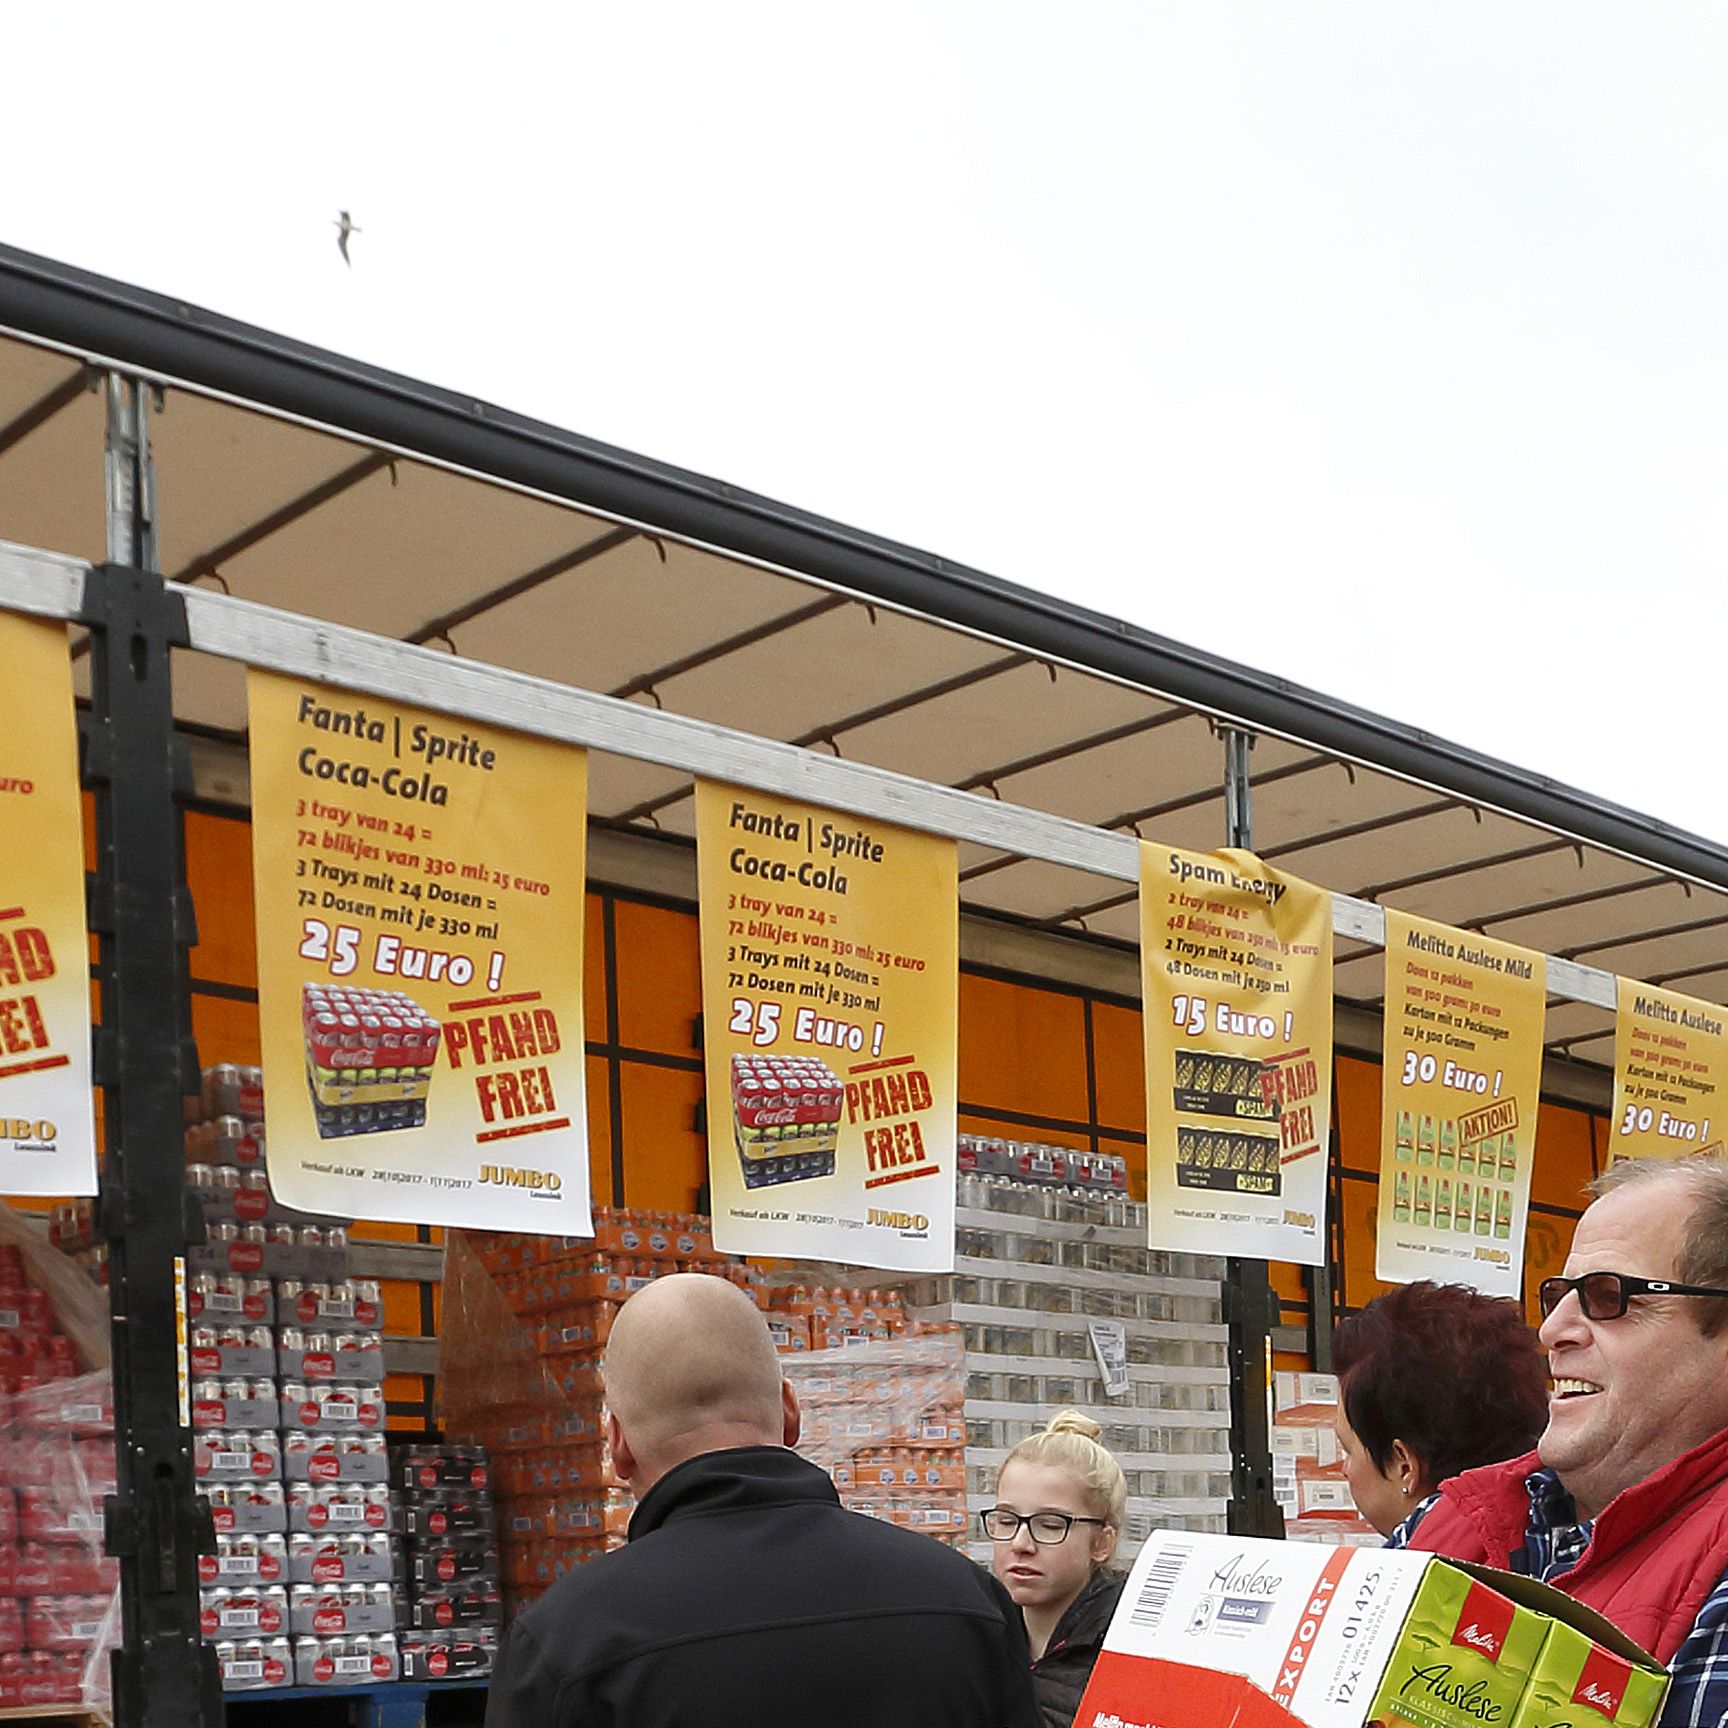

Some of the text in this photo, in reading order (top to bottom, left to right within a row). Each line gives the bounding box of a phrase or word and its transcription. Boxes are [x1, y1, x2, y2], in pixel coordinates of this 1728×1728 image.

[299, 694, 496, 770] Fanta Sprite
[299, 747, 448, 807] Coca-Cola
[312, 800, 415, 841] tray van 24
[730, 803, 884, 863] Fanta Sprite
[297, 830, 317, 848] 72
[322, 832, 380, 861] blikjes
[386, 851, 419, 868] van
[424, 858, 455, 876] 330
[493, 871, 509, 889] 25
[514, 877, 550, 897] euro
[312, 860, 481, 909] Trays mit 24 Dosen
[730, 848, 848, 894] Coca-Cola
[1169, 854, 1225, 885] Spam
[298, 889, 498, 940] 72 Dosen mit je 330 ml
[740, 894, 804, 919] tray van
[300, 919, 474, 986] 25 Euro
[740, 946, 869, 984] Trays mit Dosen
[748, 921, 925, 972] blikjes euro
[1407, 930, 1533, 980] Melitta Auslese Mild
[748, 973, 824, 999] Dosen mit
[441, 1009, 561, 1070] PFAND
[729, 997, 864, 1053] 25 Euro
[1173, 994, 1276, 1039] 15 Euro
[1633, 997, 1722, 1035] Melitta Auslese
[476, 1067, 556, 1123] FREI
[1259, 1059, 1318, 1110] PFAND
[1402, 1050, 1487, 1094] 30 Euro
[844, 1070, 933, 1125] PFAND
[864, 1121, 925, 1172] FREI
[1279, 1104, 1315, 1149] FREI
[1621, 1103, 1697, 1142] 30 Euro
[478, 1165, 561, 1191] JUMBO
[866, 1208, 929, 1231] JUMBO
[1209, 1553, 1282, 1595] Auslese
[1274, 1577, 1336, 1706] EXPORT
[1460, 1624, 1499, 1652] Melitta
[1400, 1664, 1504, 1724] Auslese
[1580, 1683, 1617, 1709] Melitta
